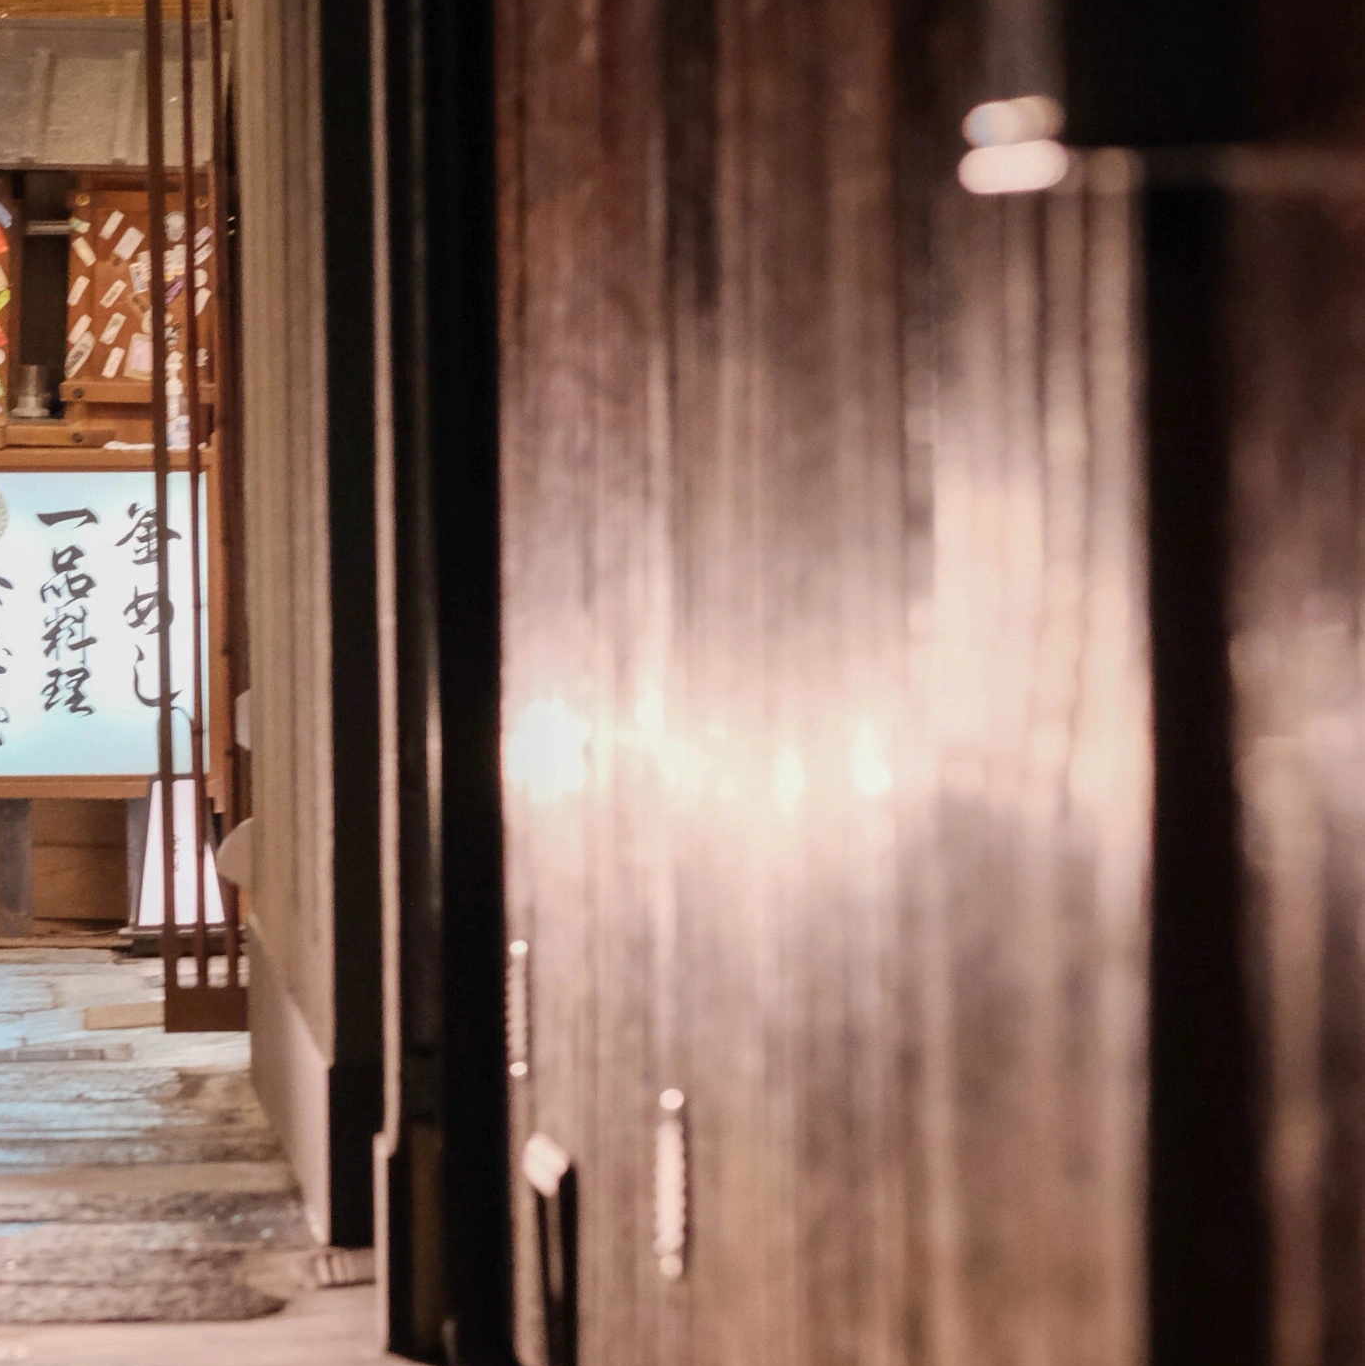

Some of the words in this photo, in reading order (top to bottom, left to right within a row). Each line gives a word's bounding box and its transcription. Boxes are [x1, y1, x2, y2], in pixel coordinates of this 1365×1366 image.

[37, 508, 100, 717] 一品料理
[114, 502, 192, 720] 釜めし
